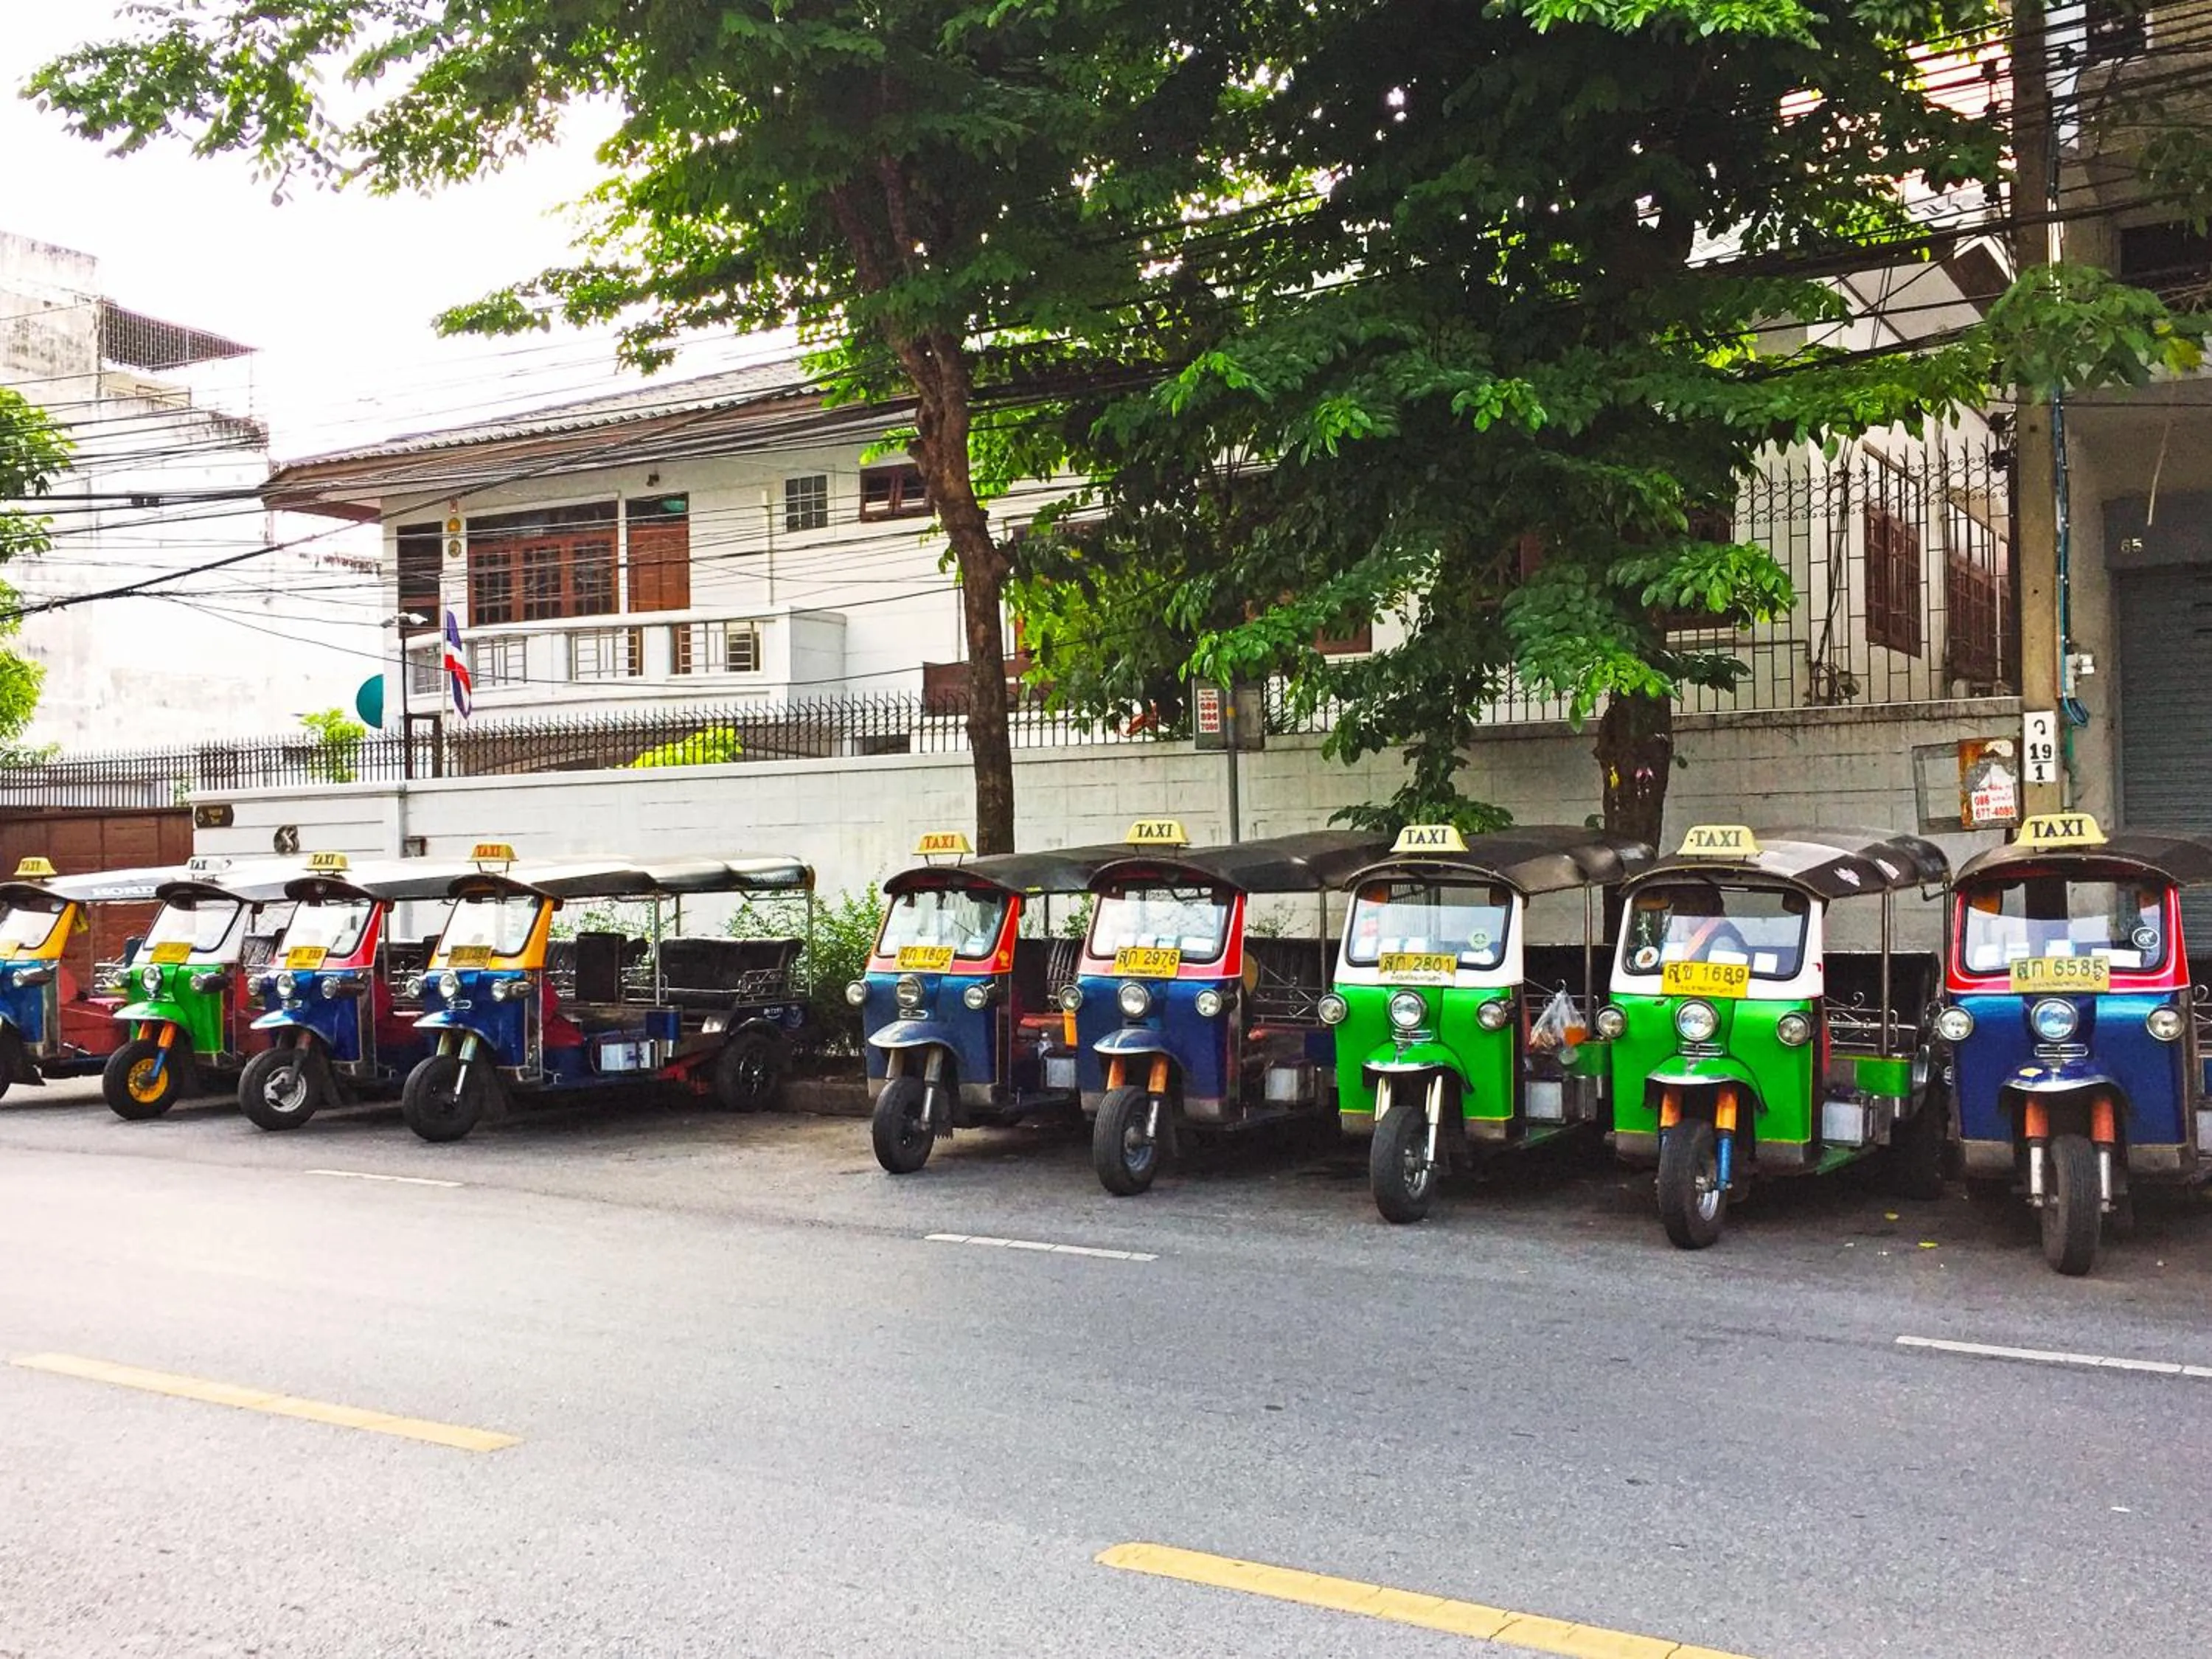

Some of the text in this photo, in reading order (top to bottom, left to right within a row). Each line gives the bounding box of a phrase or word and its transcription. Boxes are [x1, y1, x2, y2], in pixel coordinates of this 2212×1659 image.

[2029, 742, 2052, 759] 19
[2034, 764, 2045, 780] 1
[1135, 824, 1172, 838] TAXI
[1405, 828, 1447, 844] TAXI
[2029, 819, 2086, 838] TAXI
[924, 834, 956, 849] TAXI
[1693, 830, 1742, 847] TAXI
[476, 844, 501, 857] TAXI
[21, 860, 41, 872] TAXI
[313, 854, 335, 865] TAXI
[1144, 951, 1178, 966] 2976
[1412, 956, 1451, 973] 2801
[1703, 965, 1745, 984] 1689
[2053, 960, 2104, 977] 6585
